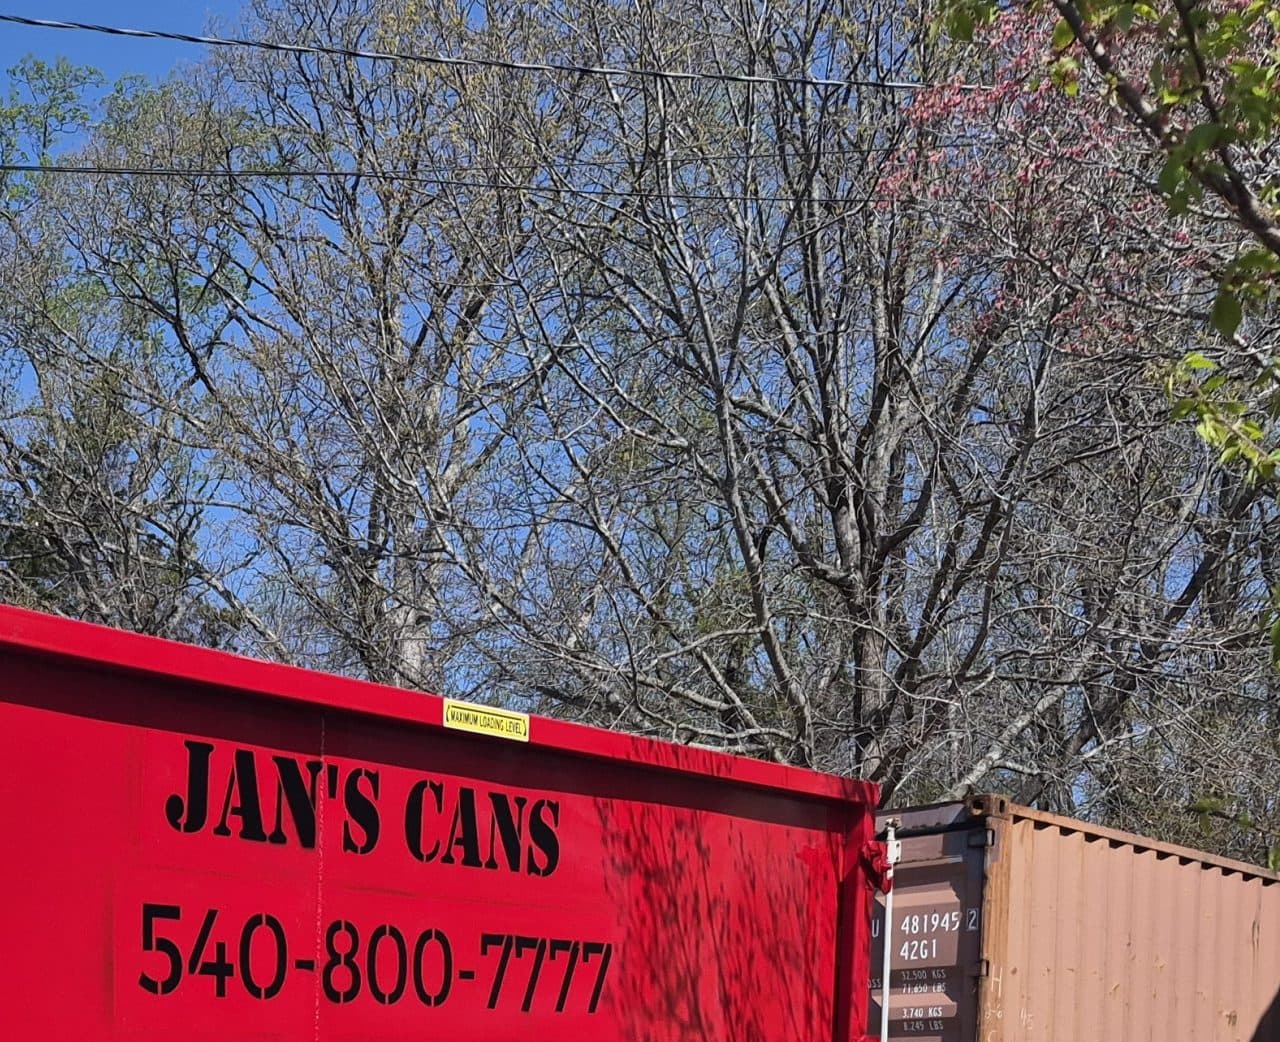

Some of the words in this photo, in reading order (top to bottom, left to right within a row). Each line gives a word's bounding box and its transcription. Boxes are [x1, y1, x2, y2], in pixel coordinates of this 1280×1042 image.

[450, 710, 478, 726] MAXIMUM
[479, 715, 504, 732] LOADING
[505, 720, 522, 735] LEVEL
[165, 740, 381, 856] JAN'S
[404, 779, 561, 877] CANS
[900, 911, 960, 935] 481945
[138, 903, 613, 1014] 540-800-7777
[900, 938, 937, 961] 42G1
[932, 968, 947, 979] KGS
[902, 1007, 924, 1018] 3.740
[928, 1007, 943, 1017] KGS
[929, 1020, 944, 1030] LBS
